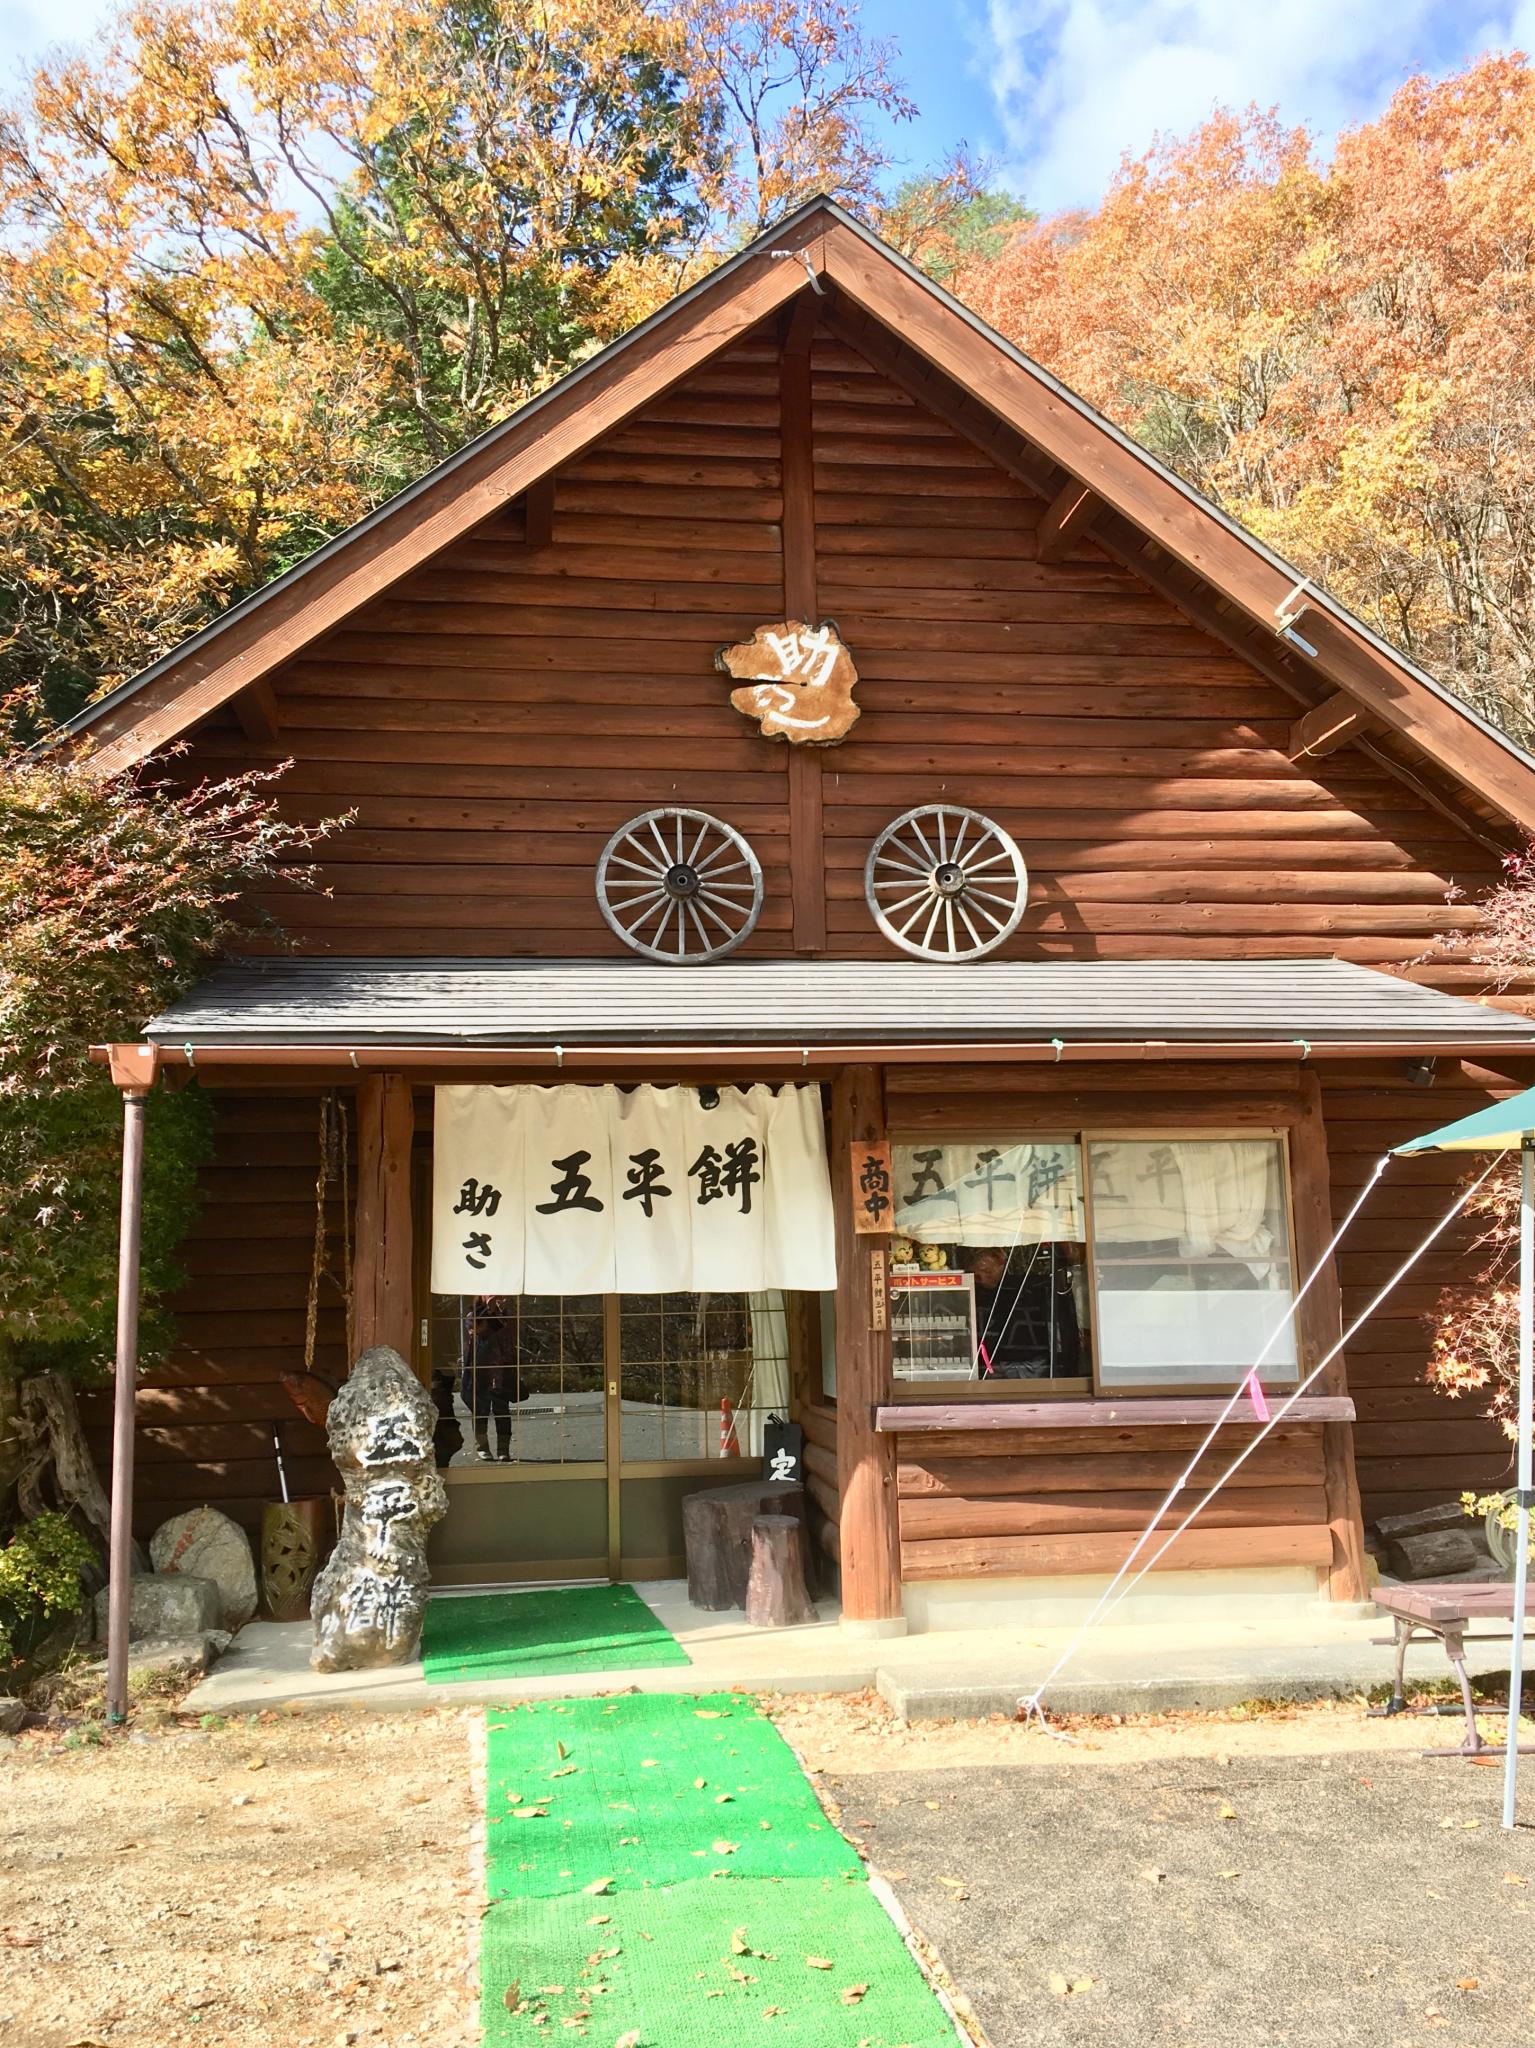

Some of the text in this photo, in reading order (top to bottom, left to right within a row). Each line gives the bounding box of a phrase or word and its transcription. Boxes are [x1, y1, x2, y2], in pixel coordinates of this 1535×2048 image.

[535, 1136, 761, 1218] 五平餅
[860, 1156, 890, 1224] 商中
[902, 1149, 1065, 1211] 五平餅
[453, 1177, 502, 1270] 助さ
[340, 1407, 425, 1650] 五平餅
